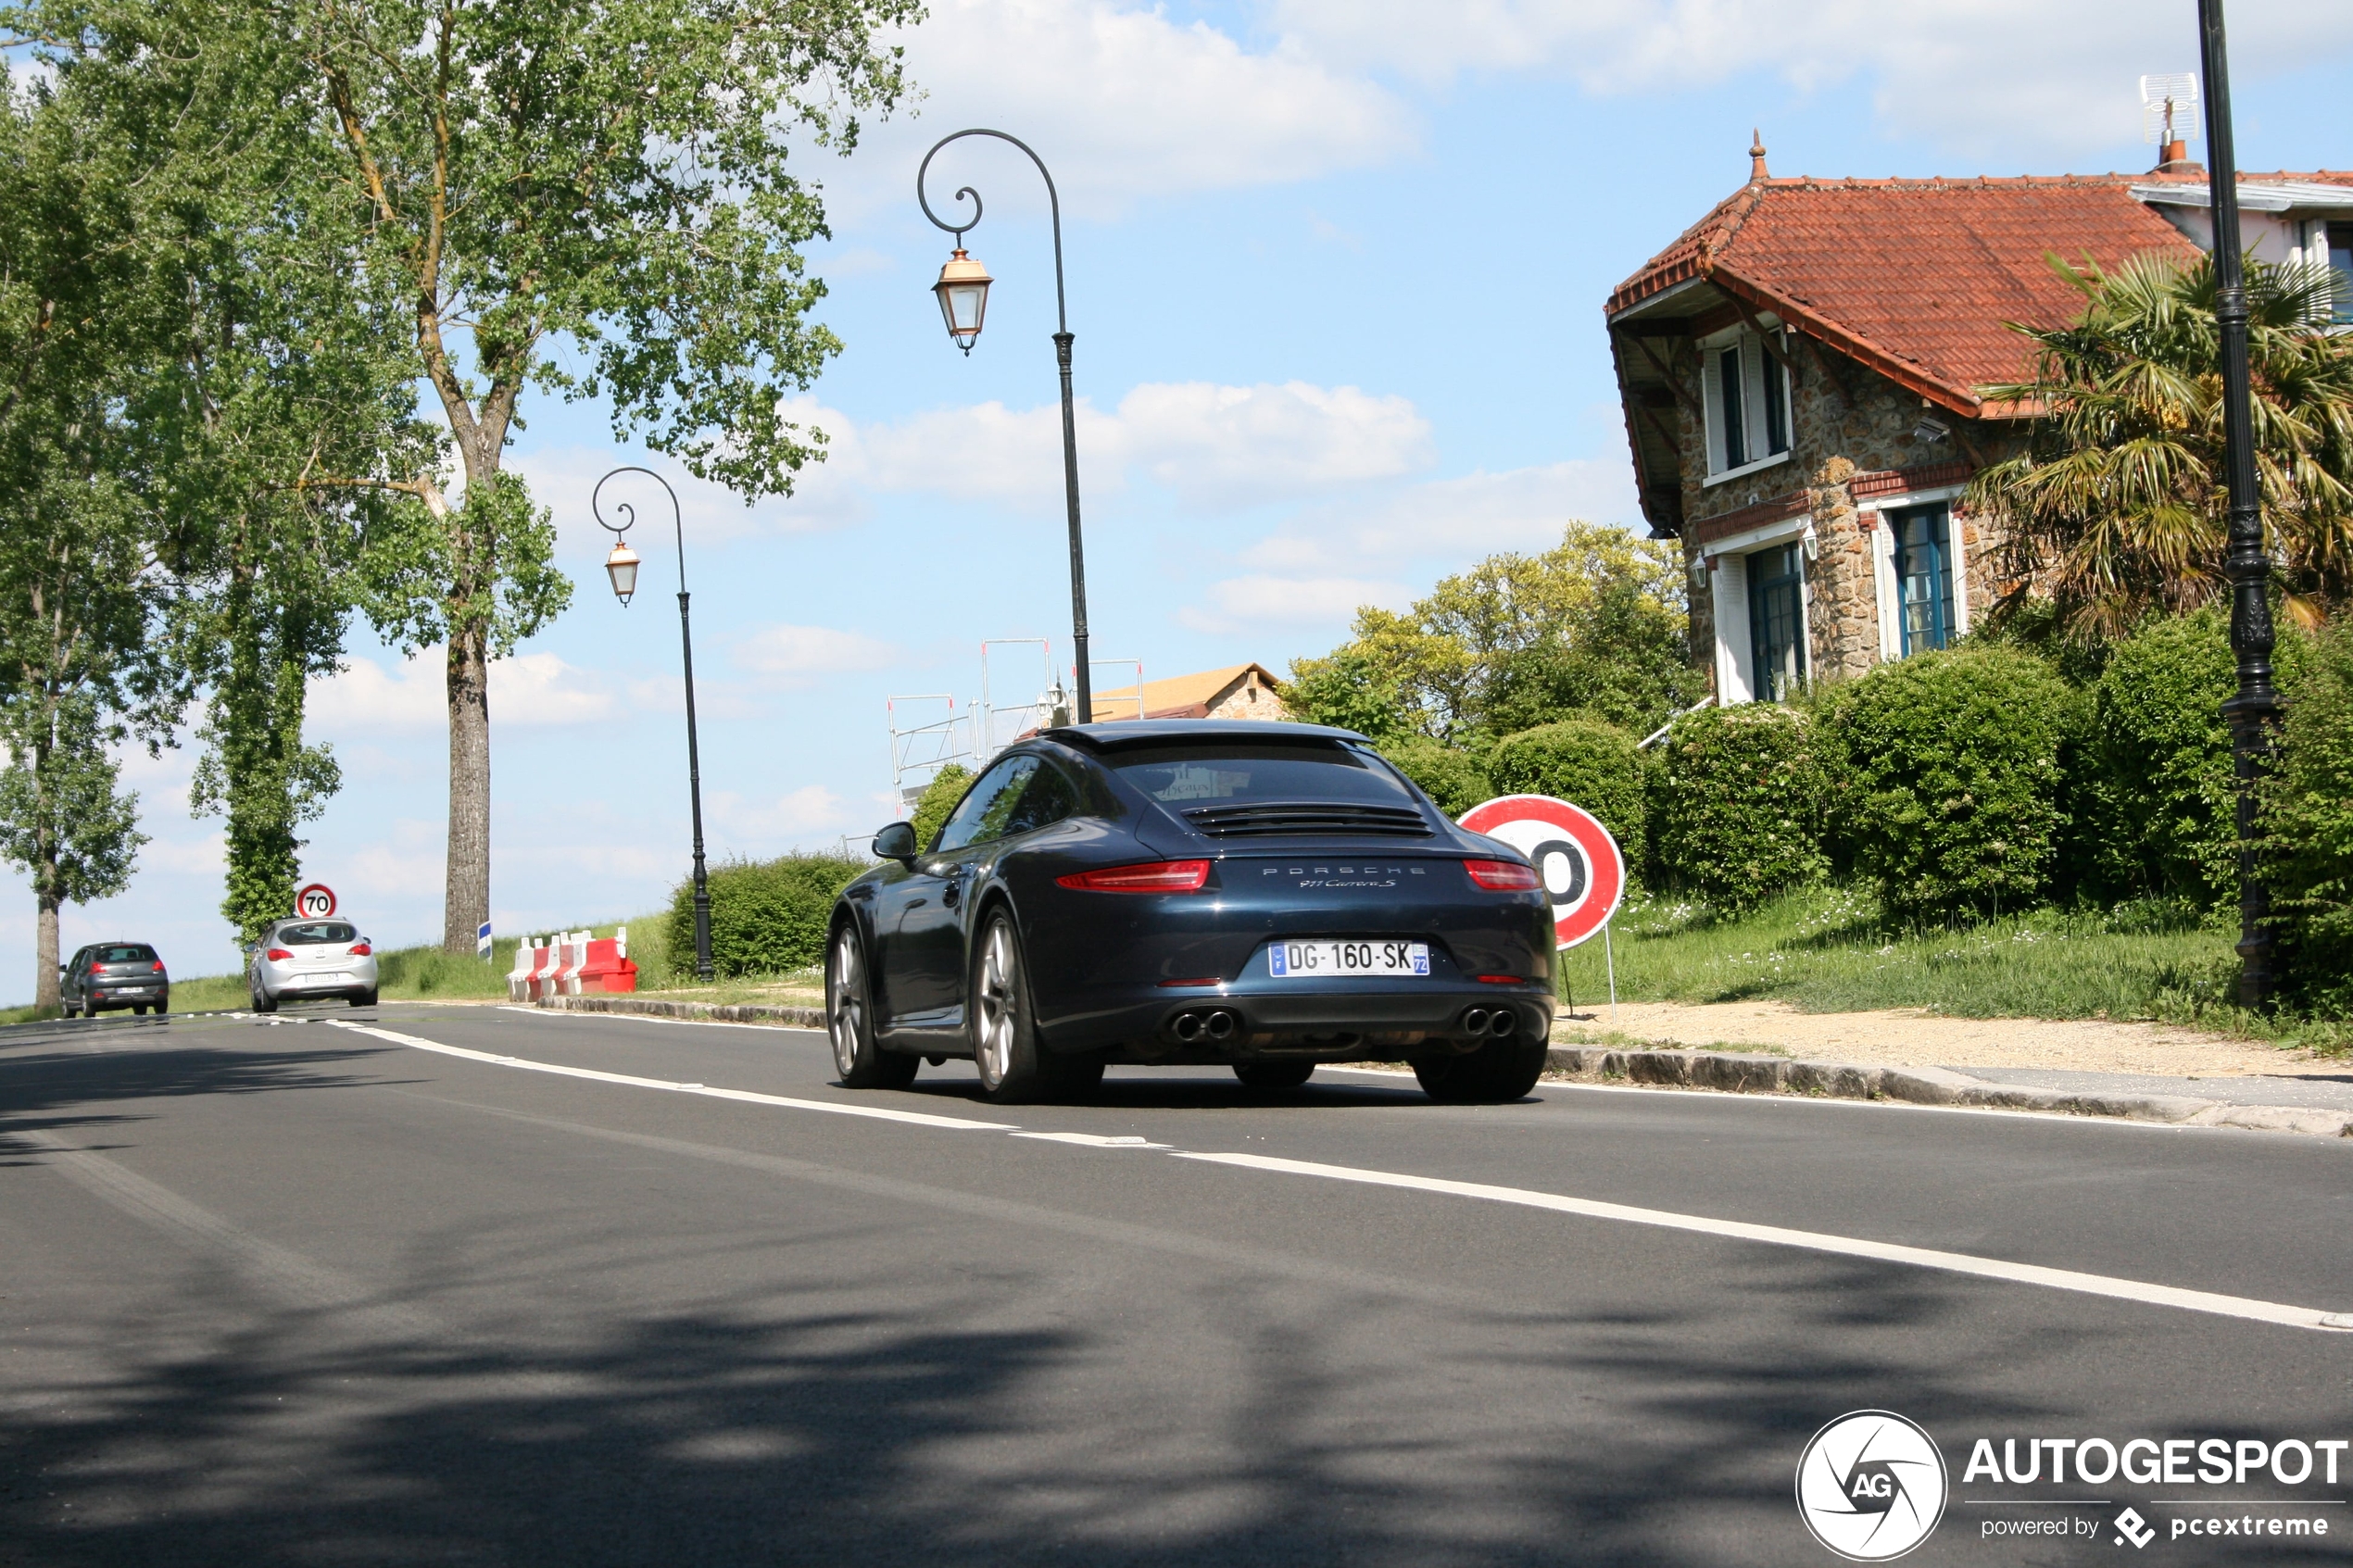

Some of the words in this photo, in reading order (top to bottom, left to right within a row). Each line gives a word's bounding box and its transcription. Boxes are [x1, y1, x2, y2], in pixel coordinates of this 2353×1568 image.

[1263, 867, 1426, 875] PORSCHE
[1326, 879, 1378, 887] Carrera
[1378, 879, 1396, 887] S
[306, 896, 329, 912] 70
[1288, 943, 1411, 970] DG-160-SK
[1276, 961, 1282, 970] F
[1414, 958, 1428, 971] 72
